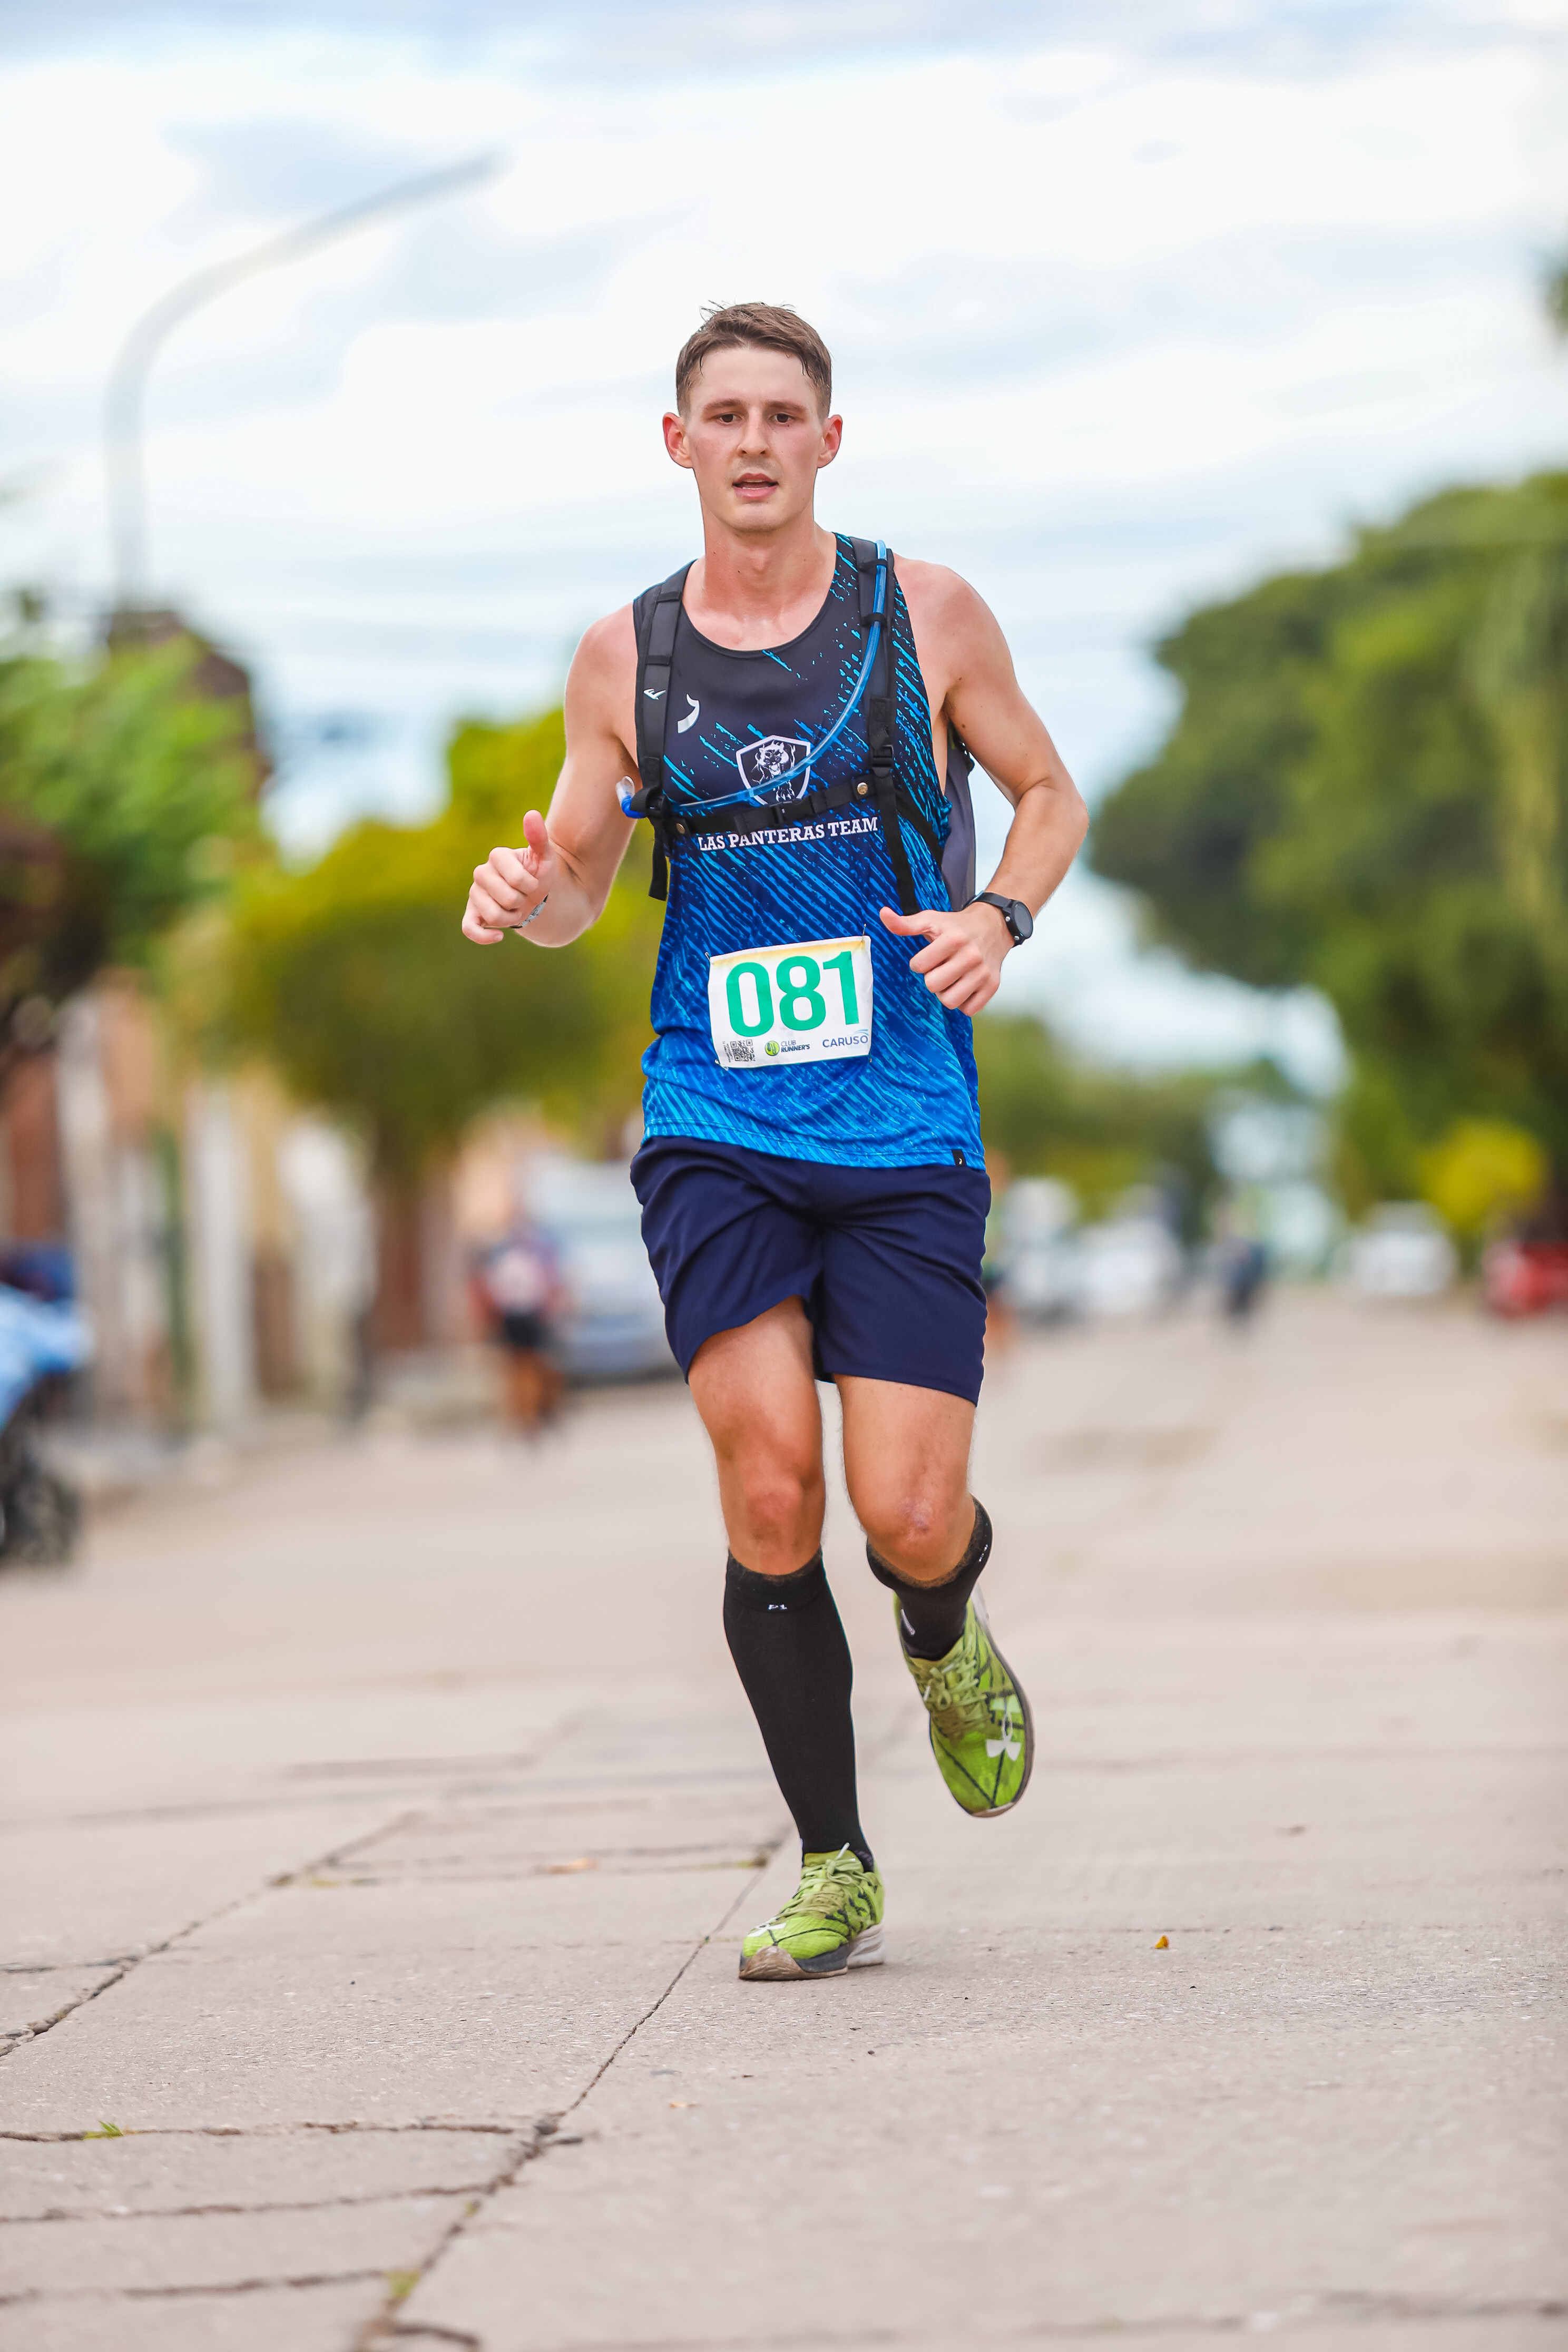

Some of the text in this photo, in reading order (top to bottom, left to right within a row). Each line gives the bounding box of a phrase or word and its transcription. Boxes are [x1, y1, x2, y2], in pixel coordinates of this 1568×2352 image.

[698, 817, 878, 851] LAS PANTERAS TEAM
[726, 951, 859, 1037] 081
[822, 1035, 868, 1047] CARUSO
